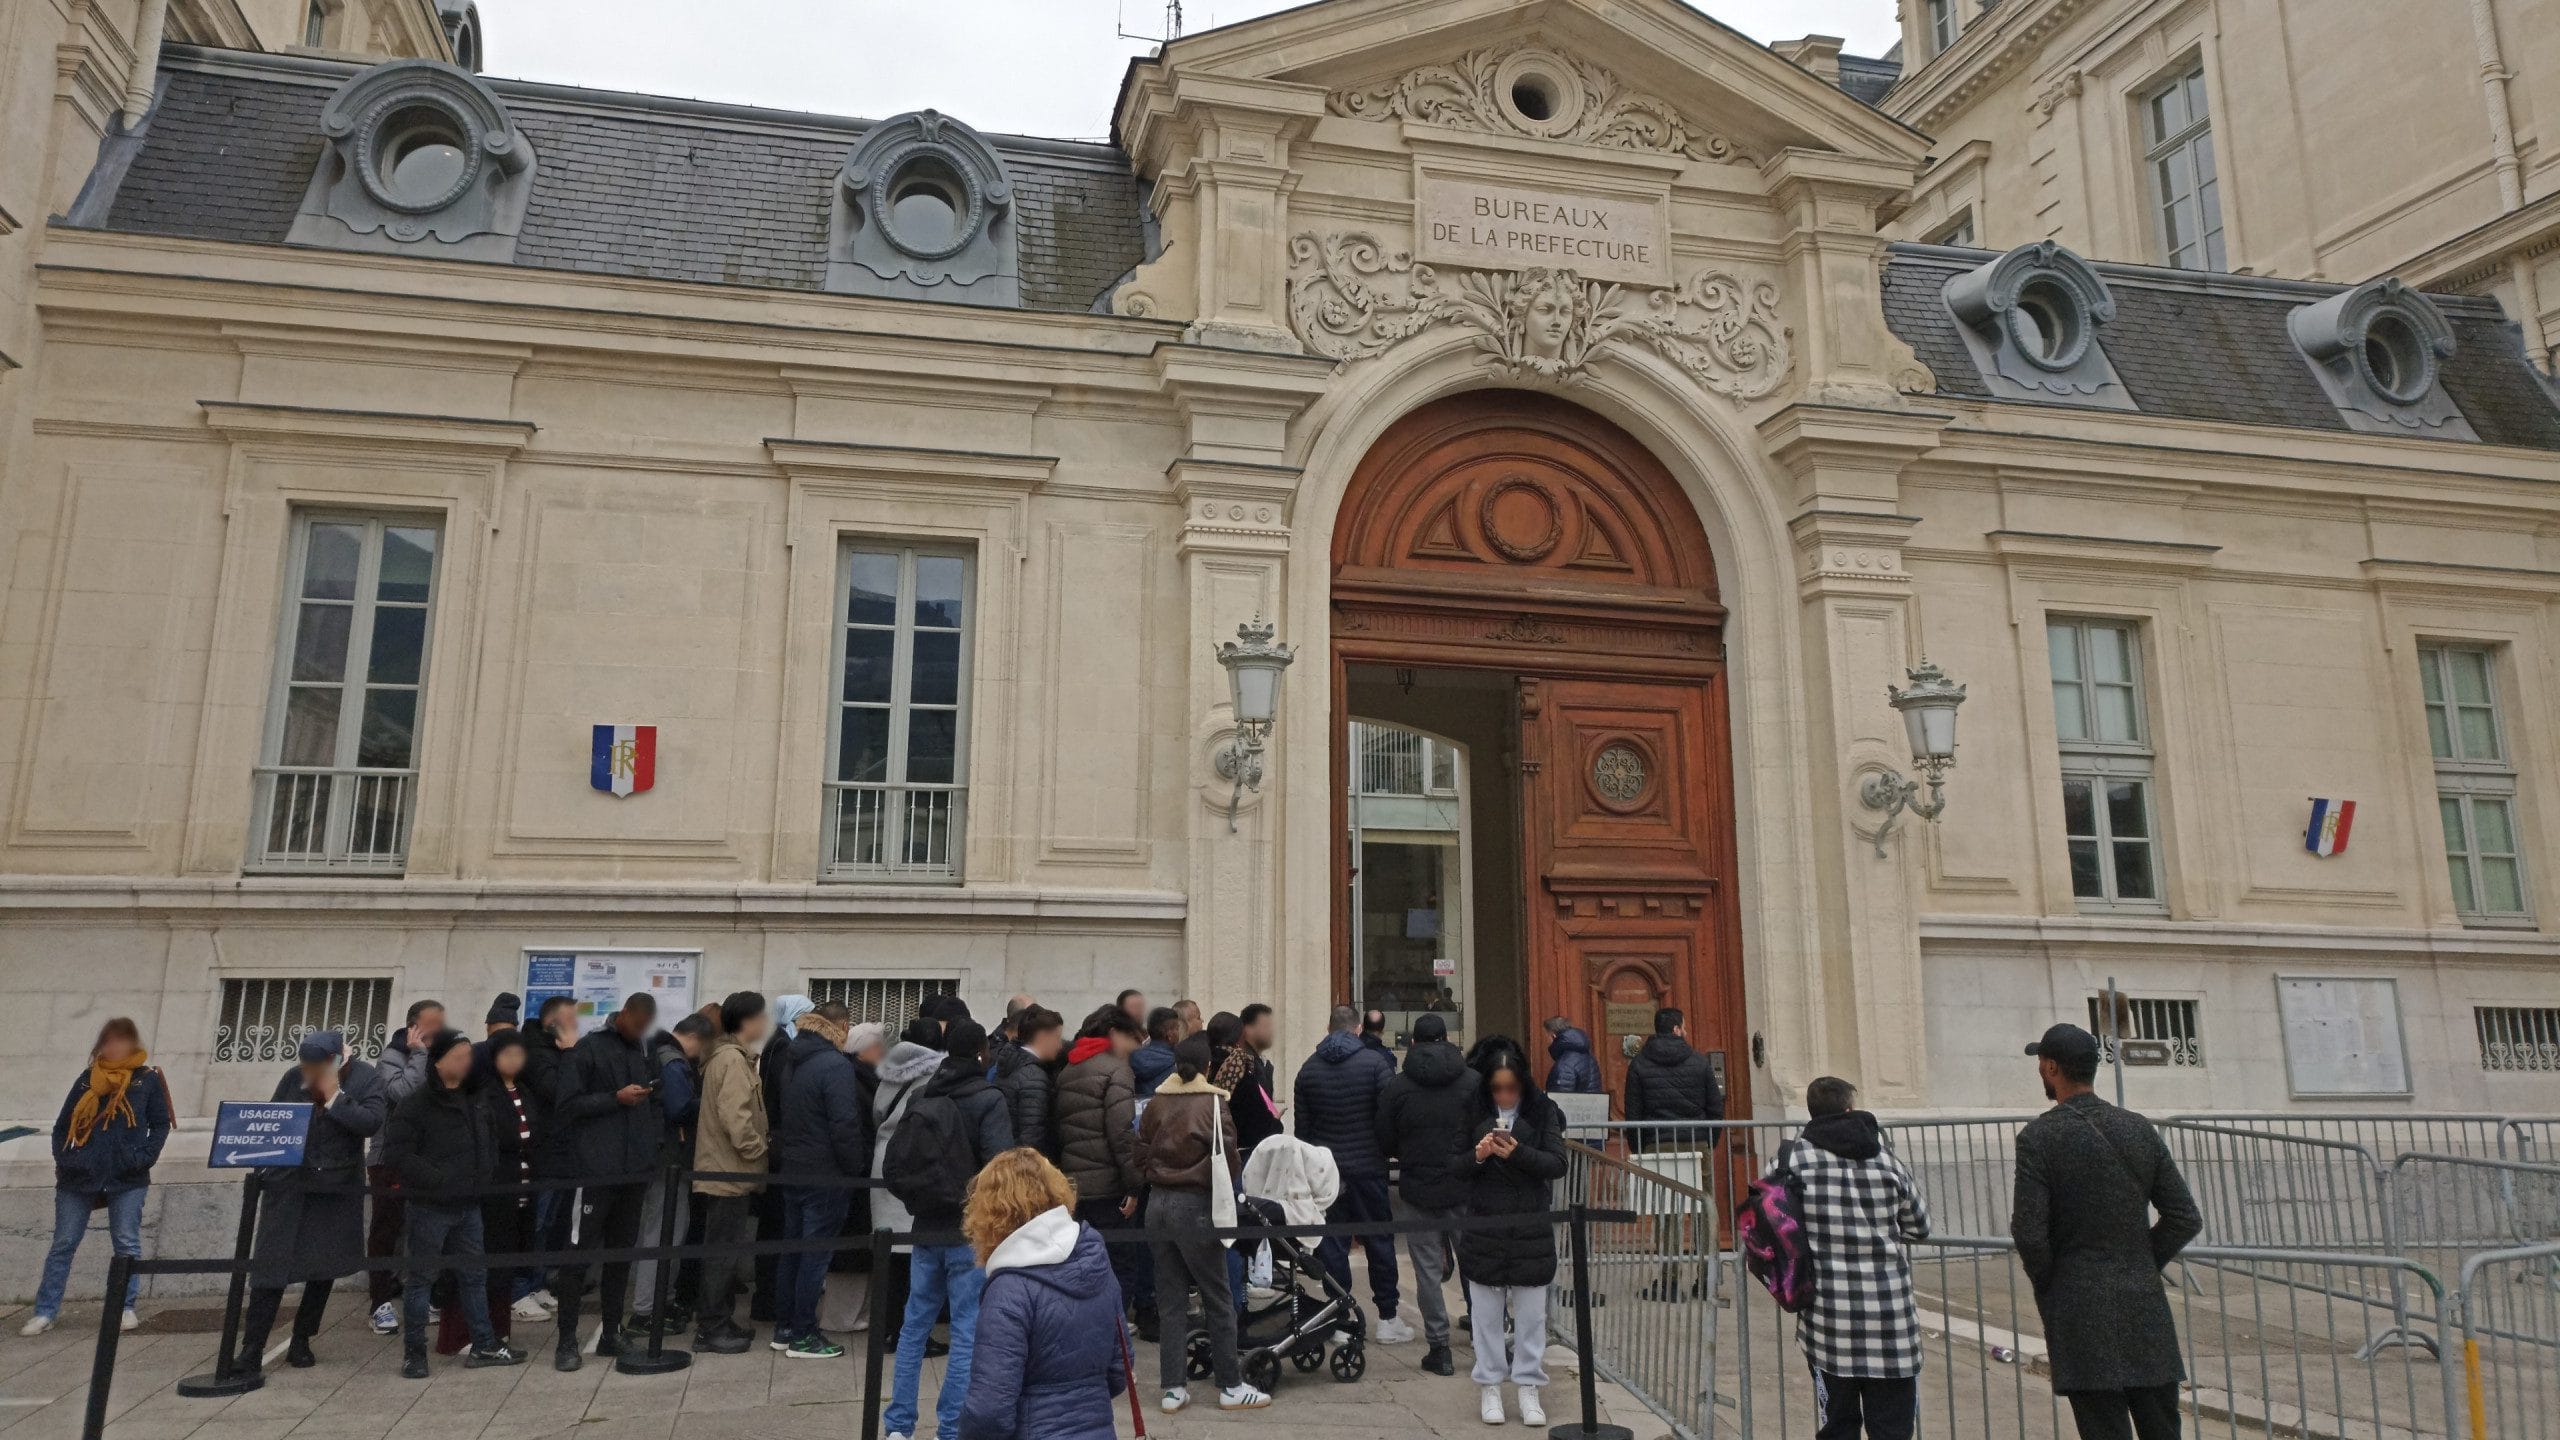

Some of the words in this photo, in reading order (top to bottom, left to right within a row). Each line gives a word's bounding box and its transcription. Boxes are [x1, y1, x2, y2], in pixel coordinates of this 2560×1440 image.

[1474, 196, 1609, 230] BUREAUX
[1433, 222, 1460, 242] DE
[1471, 227, 1498, 248] LA
[1508, 231, 1650, 263] PREFECTURE
[239, 1109, 293, 1119] USAGERS
[246, 1122, 280, 1131] AVEC
